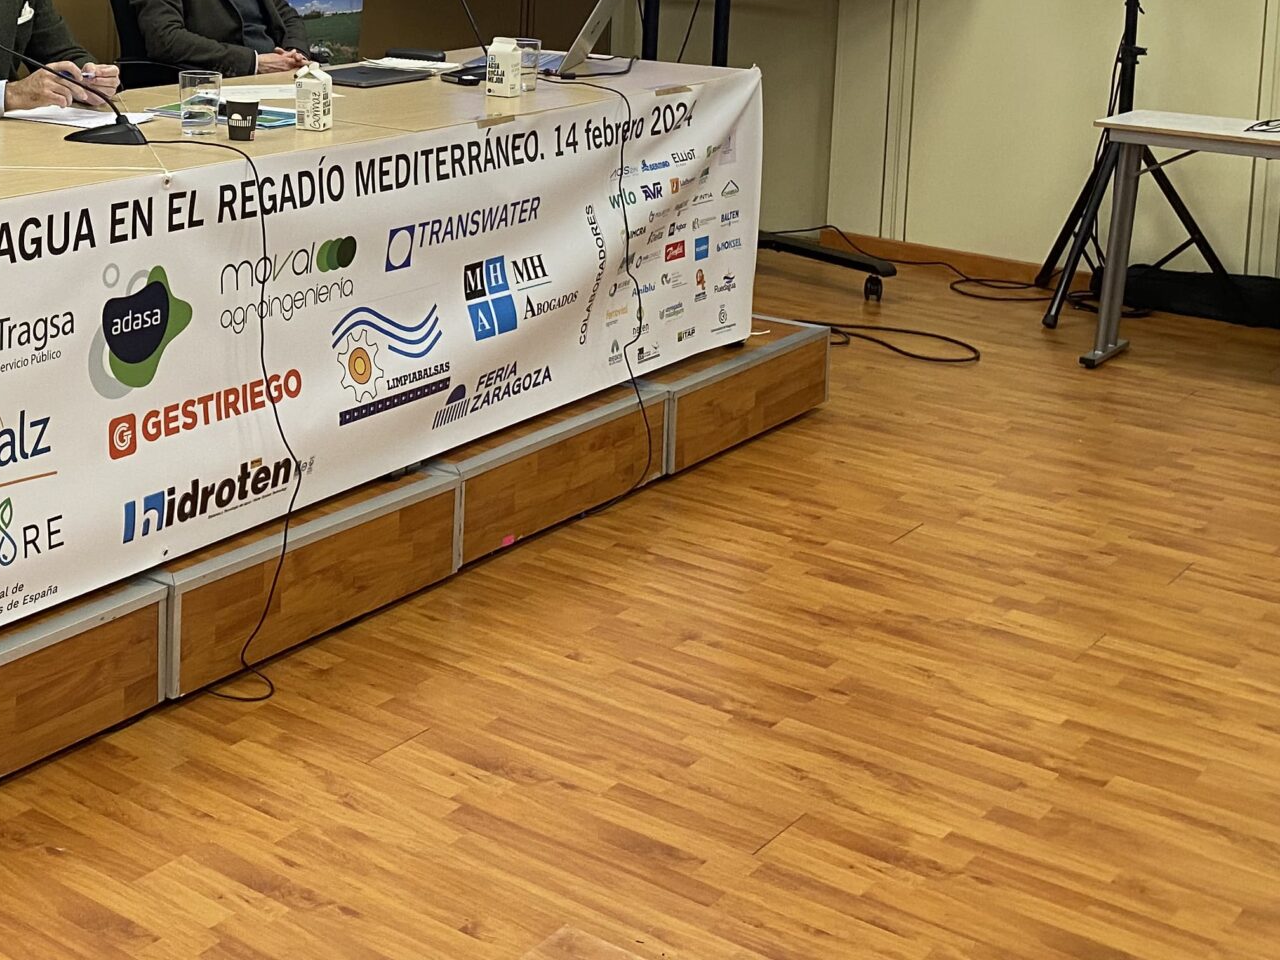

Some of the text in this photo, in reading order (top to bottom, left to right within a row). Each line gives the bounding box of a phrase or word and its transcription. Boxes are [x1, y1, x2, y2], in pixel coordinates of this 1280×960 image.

[110, 196, 152, 244] EN
[168, 190, 204, 232] EL
[218, 156, 344, 223] REGADÍO
[355, 128, 544, 197] MEDITERRÁNEO.
[554, 122, 578, 157] 14
[584, 117, 646, 150] febrero
[650, 99, 698, 136] 2024
[609, 188, 636, 209] wlo
[418, 196, 540, 248] TRANSWATER
[220, 241, 316, 295] moval
[512, 253, 550, 284] MH
[579, 204, 606, 345] COLABORADORES
[220, 276, 354, 334] agroingeniería
[111, 308, 162, 336] adasa
[30, 350, 62, 366] Público
[386, 361, 450, 391] LIMPIABALSAS
[470, 365, 552, 414] ZARAGOZA
[476, 360, 518, 392] FERIA
[142, 368, 302, 442] GESTIRIEGO
[6, 599, 19, 612] de
[22, 584, 58, 606] España
[12, 582, 24, 592] de
